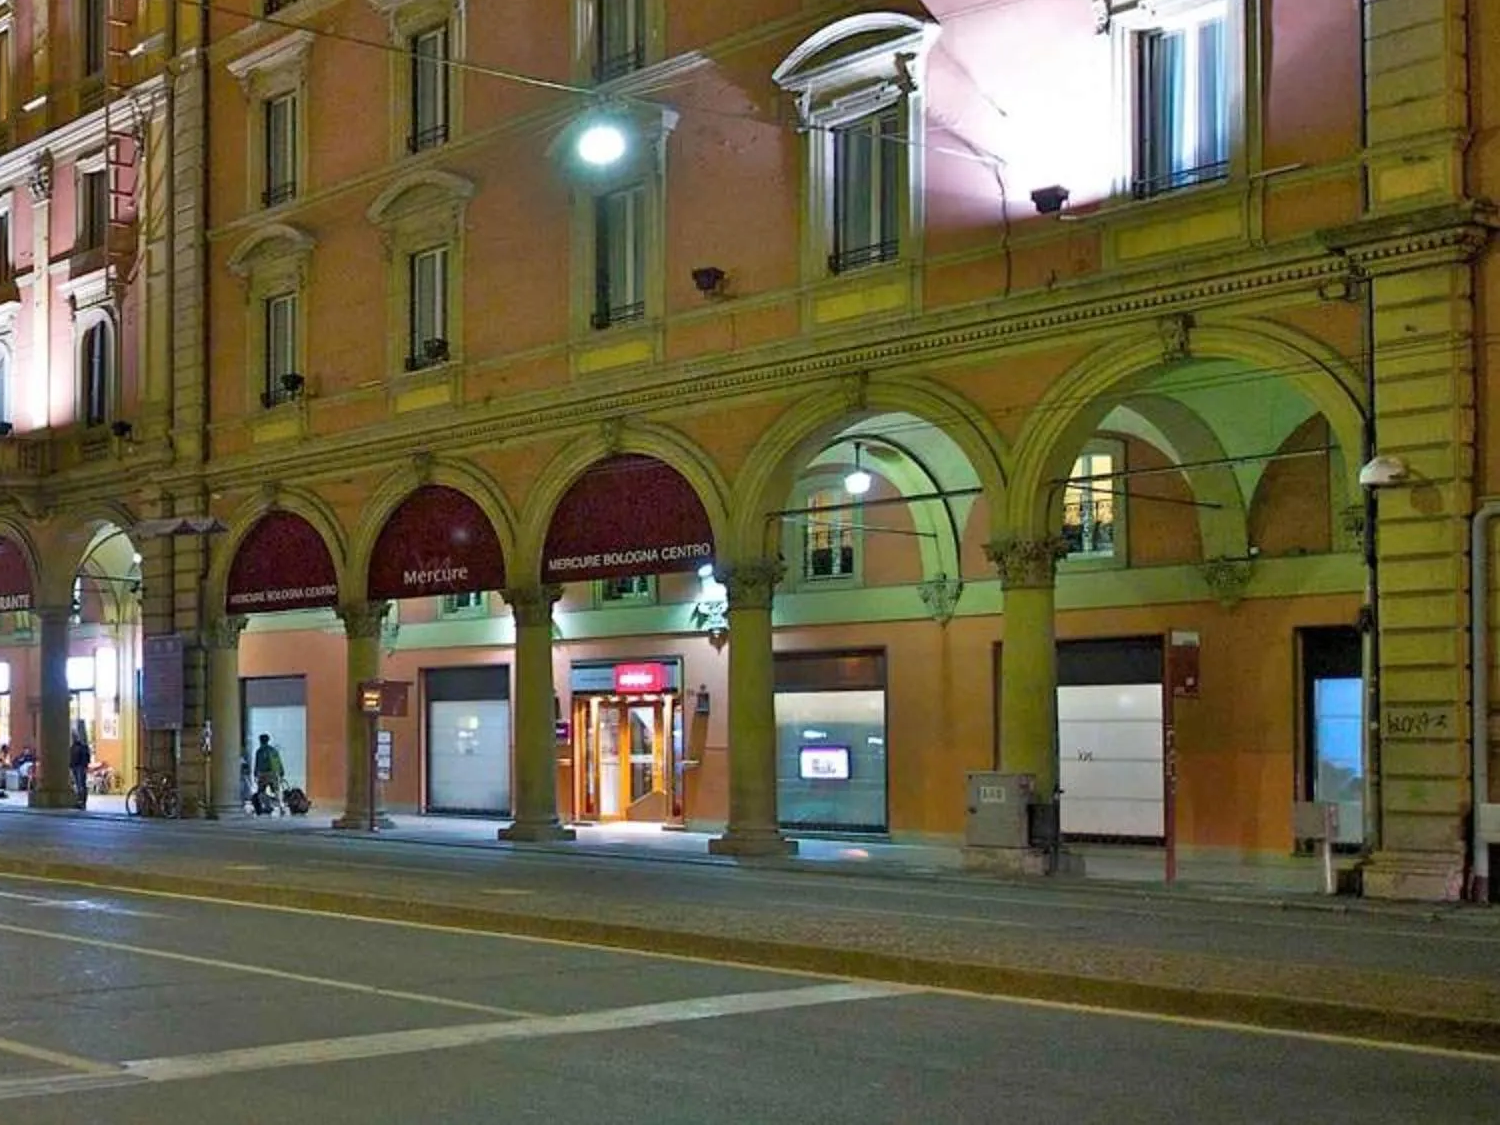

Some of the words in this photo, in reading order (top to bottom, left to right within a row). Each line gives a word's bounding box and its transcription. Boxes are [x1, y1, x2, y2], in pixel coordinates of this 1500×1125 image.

[548, 554, 601, 571] MERCURE
[603, 548, 659, 566] BOLOGNA
[661, 542, 711, 561] CENTRO
[403, 566, 469, 585] Mercure
